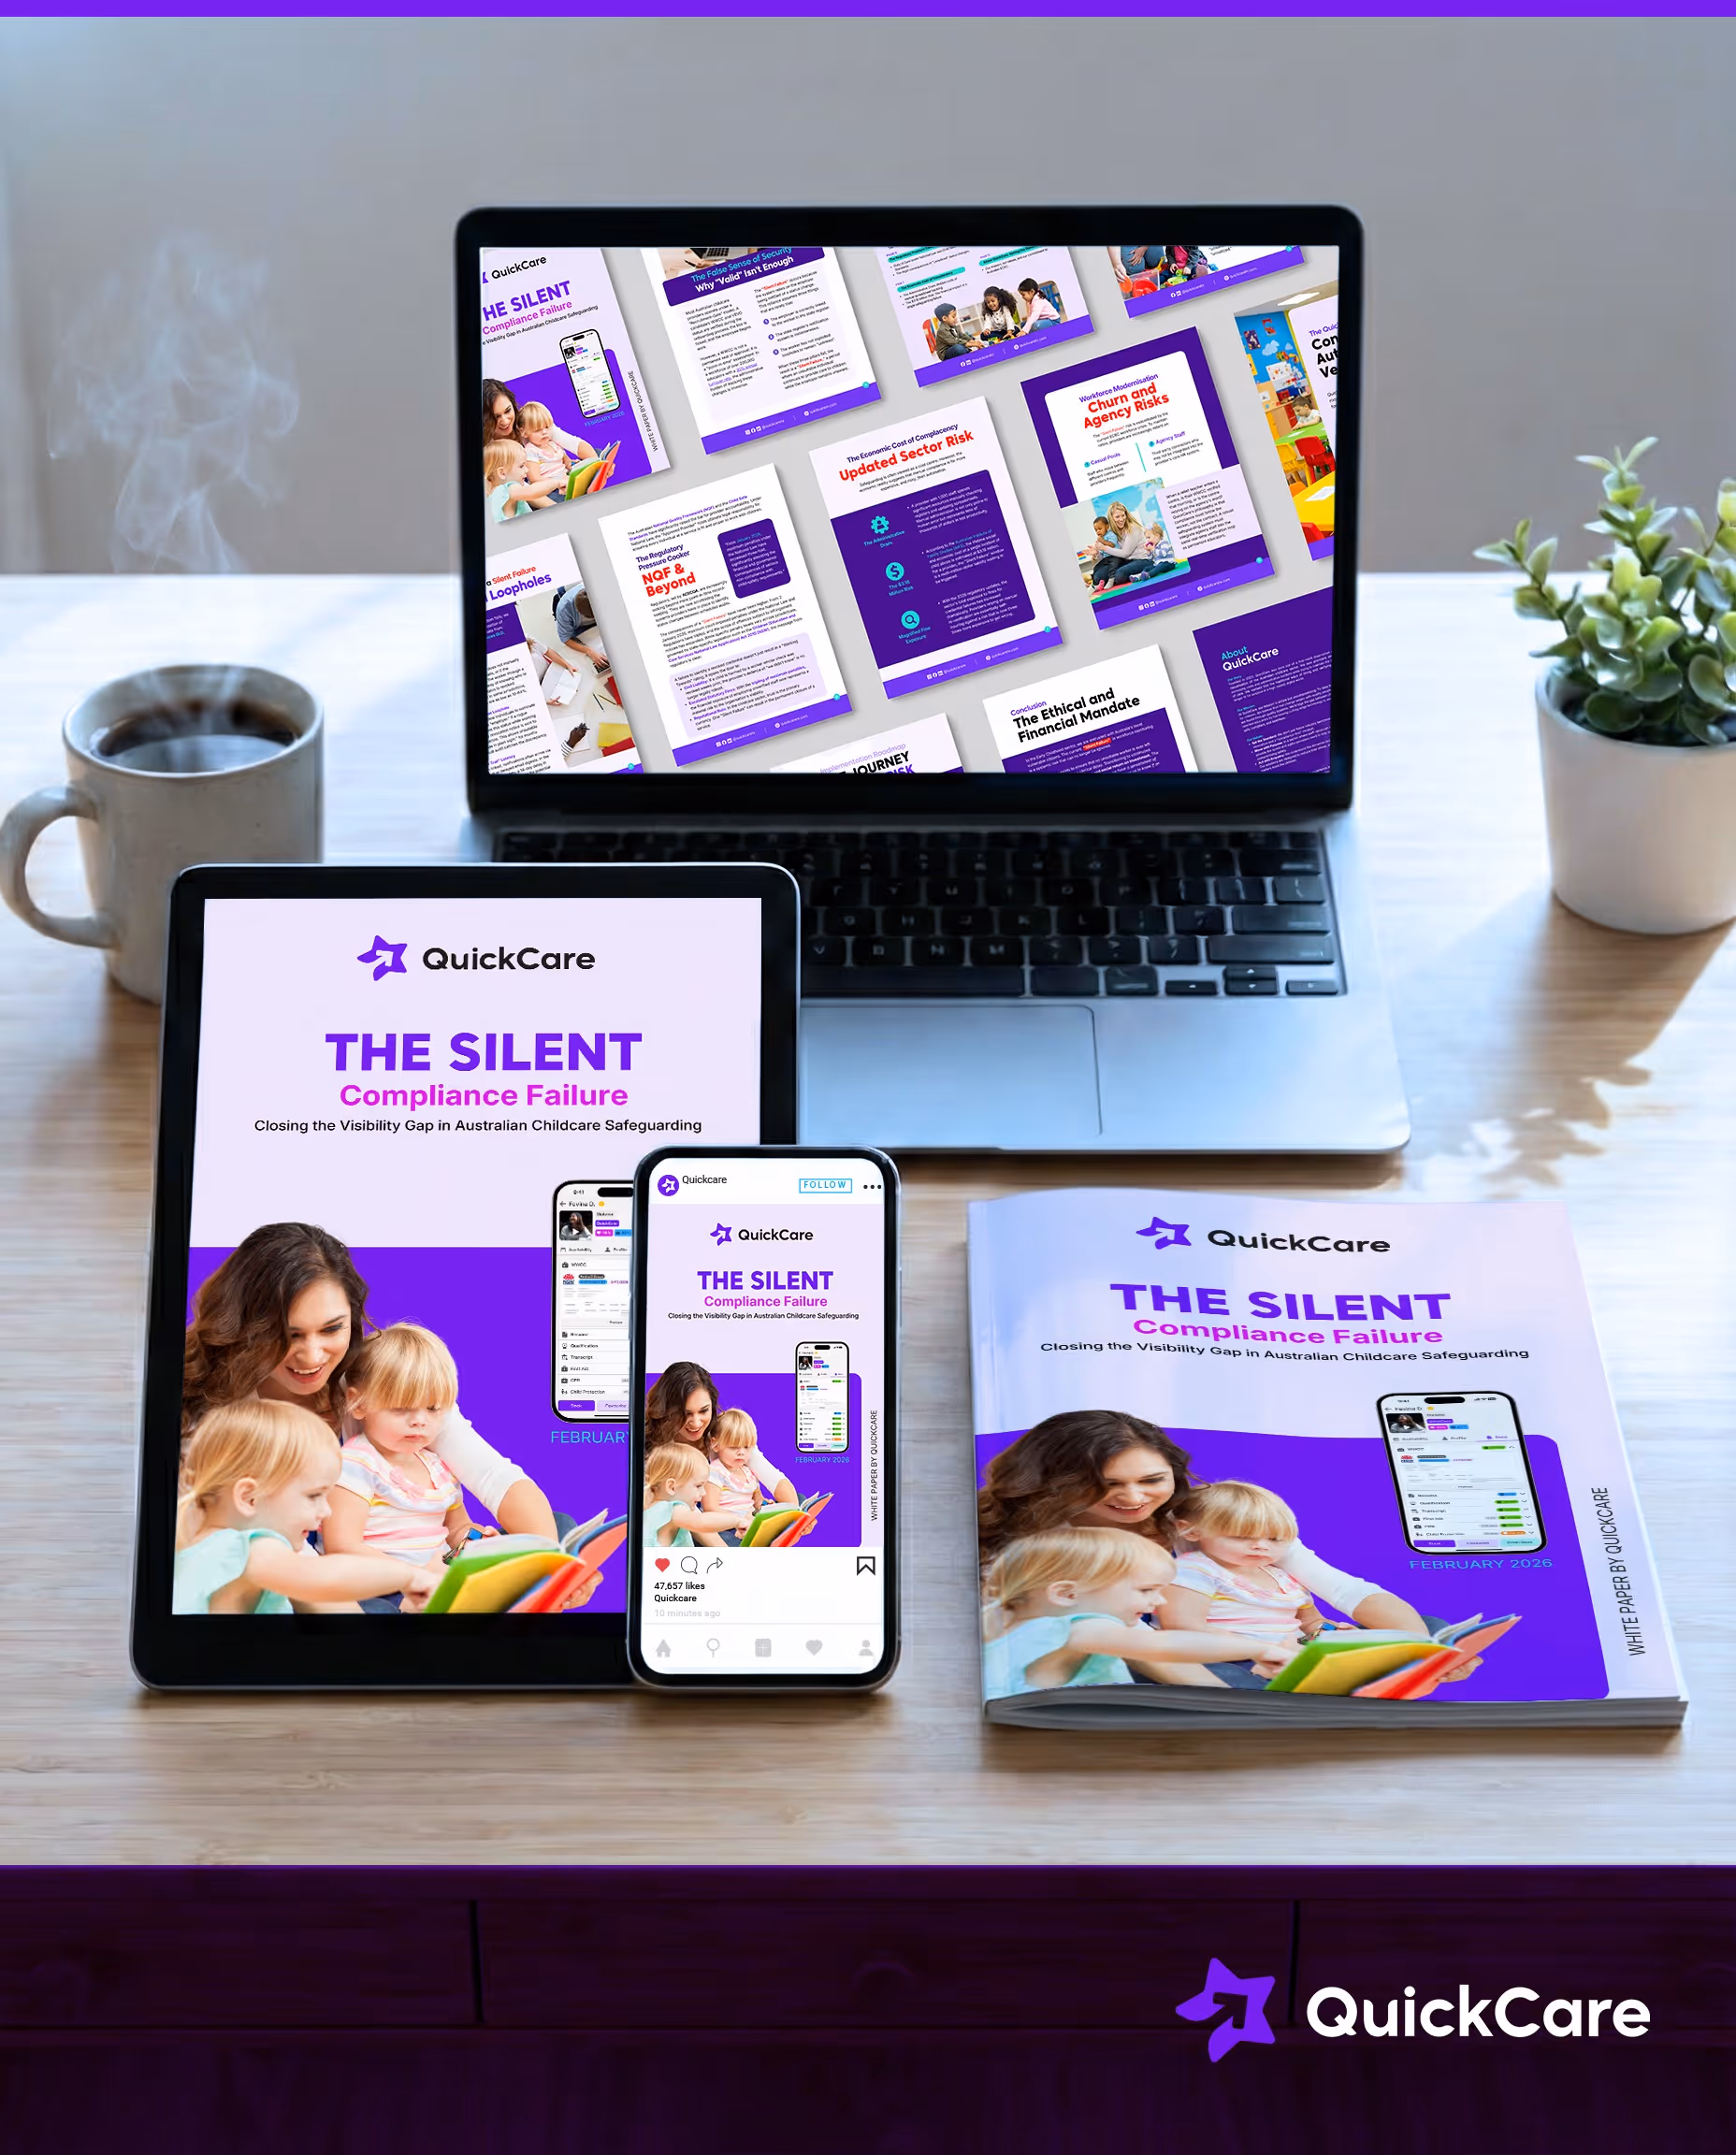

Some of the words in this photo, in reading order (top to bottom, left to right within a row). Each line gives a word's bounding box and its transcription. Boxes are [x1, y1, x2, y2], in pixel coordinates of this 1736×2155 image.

[491, 256, 546, 279] QuickCare
[690, 273, 705, 282] The
[706, 267, 727, 278] False
[728, 259, 752, 270] Sense
[751, 253, 760, 263] of
[760, 247, 792, 261] Security
[694, 282, 714, 292] Why
[715, 270, 742, 284] "Valid"
[743, 265, 762, 277] Isn't
[761, 255, 794, 270] Enough
[510, 280, 570, 311] SILENT
[482, 311, 540, 336] Compliance
[539, 301, 571, 316] Failure
[485, 334, 505, 343] Visibility
[521, 322, 544, 332] Australian
[543, 314, 567, 325] Childcare
[567, 305, 598, 318] Safeguarding
[1309, 328, 1322, 337] The
[1321, 322, 1339, 333] Quic
[628, 370, 643, 404] QUICKCARE
[1078, 388, 1112, 402] Workforce
[1112, 373, 1158, 392] Modernisation
[1088, 394, 1128, 412] Churn
[1131, 382, 1157, 399] and
[638, 404, 645, 412] BY
[1084, 405, 1131, 428] Agency
[1134, 394, 1169, 412] Risks
[641, 413, 652, 432] PAPER
[647, 432, 658, 452] WHITE
[860, 444, 891, 459] Economic
[891, 440, 907, 448] Cost
[915, 424, 958, 441] Complacency
[1155, 435, 1173, 444] Agency
[838, 453, 898, 481] Updated
[899, 441, 942, 461] Sector
[945, 429, 974, 447] Risk
[1090, 456, 1107, 465] Casual
[638, 557, 667, 571] Pressure
[666, 550, 689, 561] Cooker
[648, 543, 683, 558] Regulatory
[491, 572, 512, 584] Silent
[512, 566, 536, 578] Failure
[642, 566, 671, 585] NQF
[673, 562, 685, 574] &
[644, 571, 696, 597] Beyond
[488, 574, 552, 600] Loopholes
[898, 629, 921, 639] Magnified
[1222, 645, 1248, 660] About
[1222, 648, 1279, 671] QuickCare
[1010, 701, 1047, 716] Conclusion
[1012, 715, 1038, 729] The
[1040, 696, 1086, 720] Ethical
[1089, 687, 1115, 704] and
[1017, 714, 1078, 743] Financial
[1078, 697, 1139, 723] Mandate
[873, 744, 905, 758] Roadmap
[423, 947, 595, 970] QuickCare
[326, 1034, 430, 1071] THE
[449, 1033, 642, 1071] SILENT
[340, 1084, 517, 1111] Compliance
[528, 1084, 628, 1106] Failure
[254, 1120, 308, 1134] Closing
[312, 1121, 336, 1131] the
[340, 1120, 400, 1134] Visibility
[405, 1121, 434, 1134] Gap
[439, 1120, 450, 1131] in
[456, 1120, 527, 1131] Australian
[532, 1120, 600, 1131] Childcare
[605, 1120, 702, 1134] Safeguarding
[683, 1175, 727, 1184] Quickcare
[803, 1180, 846, 1189] FOLLOW
[738, 1229, 813, 1240] QuickCare
[1208, 1230, 1390, 1252] QuickCare
[697, 1271, 743, 1290] THE
[751, 1271, 833, 1290] SILENT
[704, 1295, 780, 1309] Compliance
[785, 1295, 827, 1307] Failure
[1110, 1284, 1230, 1315] THE
[1249, 1292, 1451, 1321] SILENT
[731, 1312, 745, 1321] Gap
[1134, 1319, 1327, 1345] Compliance
[1333, 1329, 1442, 1344] Failure
[1041, 1342, 1103, 1352] Closing
[1137, 1343, 1205, 1355] Visibility
[1210, 1347, 1241, 1357] Gap
[1246, 1349, 1259, 1357] in
[1265, 1351, 1338, 1360] Australian
[1422, 1350, 1529, 1360] Safeguarding
[871, 1457, 877, 1467] BY
[1591, 1488, 1622, 1554] QUICKCARE
[1410, 1560, 1504, 1570] FEBRUARY
[1511, 1558, 1553, 1569] 2026
[1608, 1557, 1627, 1572] BY
[655, 1594, 697, 1602] Quickcare
[1613, 1576, 1636, 1613] PAPER
[1622, 1617, 1645, 1656] WHITE
